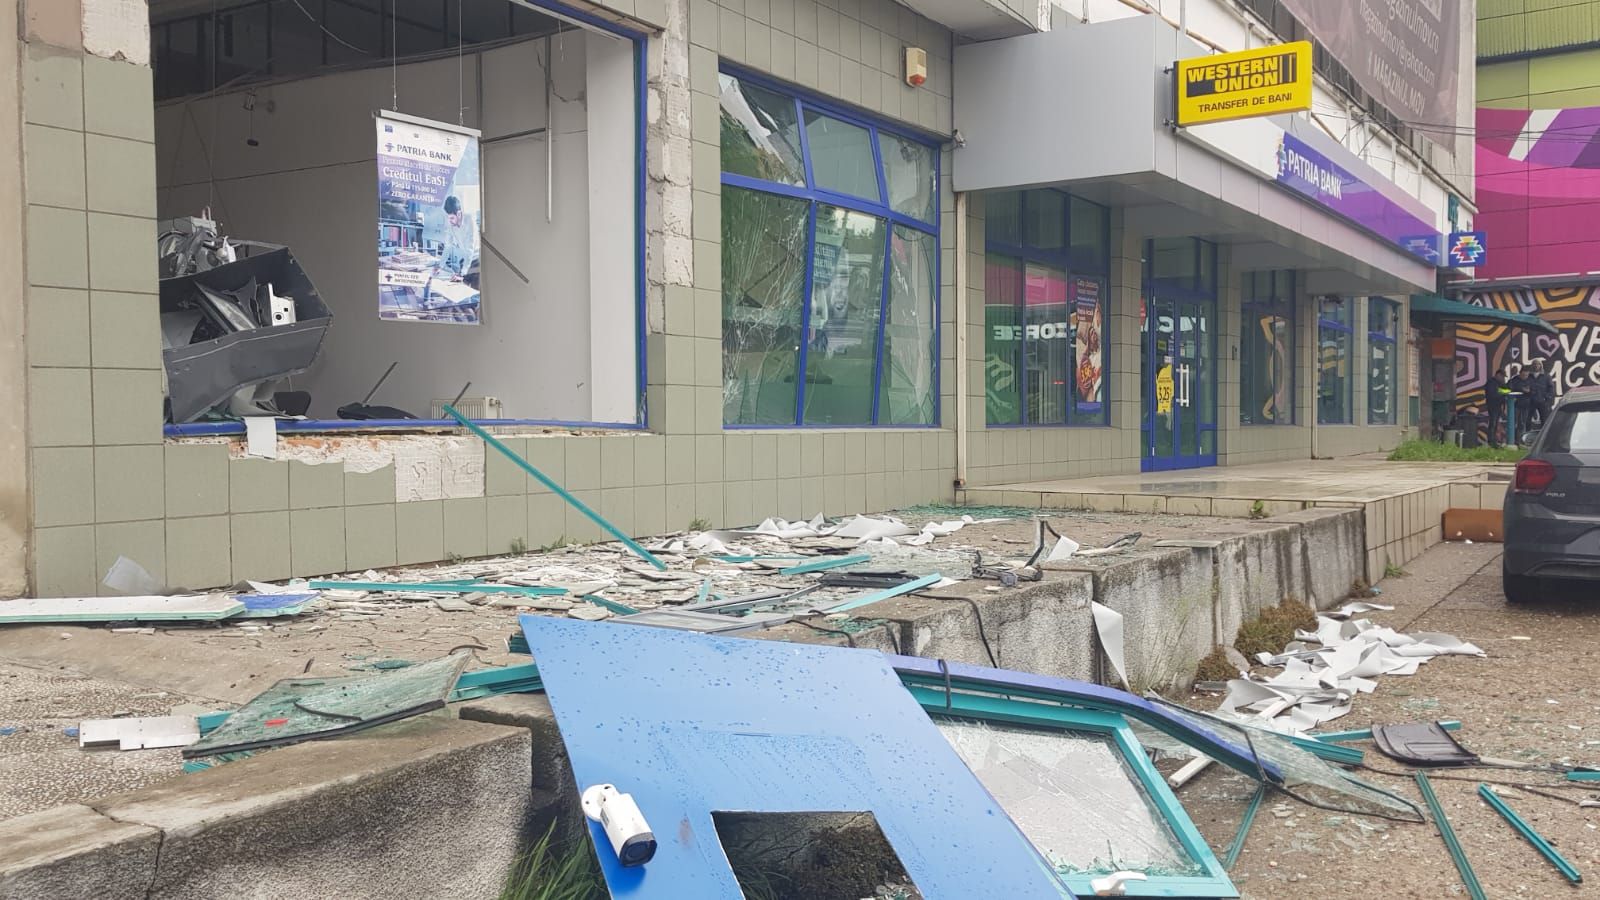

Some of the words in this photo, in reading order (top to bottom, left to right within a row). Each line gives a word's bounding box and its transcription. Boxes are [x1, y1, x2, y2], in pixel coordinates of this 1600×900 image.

[1188, 56, 1278, 82] WESTERN
[1214, 71, 1278, 93] UNION
[1198, 99, 1249, 113] TRANSFER
[1252, 96, 1265, 106] DE
[1268, 92, 1293, 104] BANI
[1408, 88, 1426, 117] MOV
[396, 144, 427, 158] PATRIA
[429, 150, 452, 162] BANK
[383, 166, 422, 182] Creditul
[1288, 149, 1319, 187] PATRIA
[1320, 169, 1342, 201] BANK
